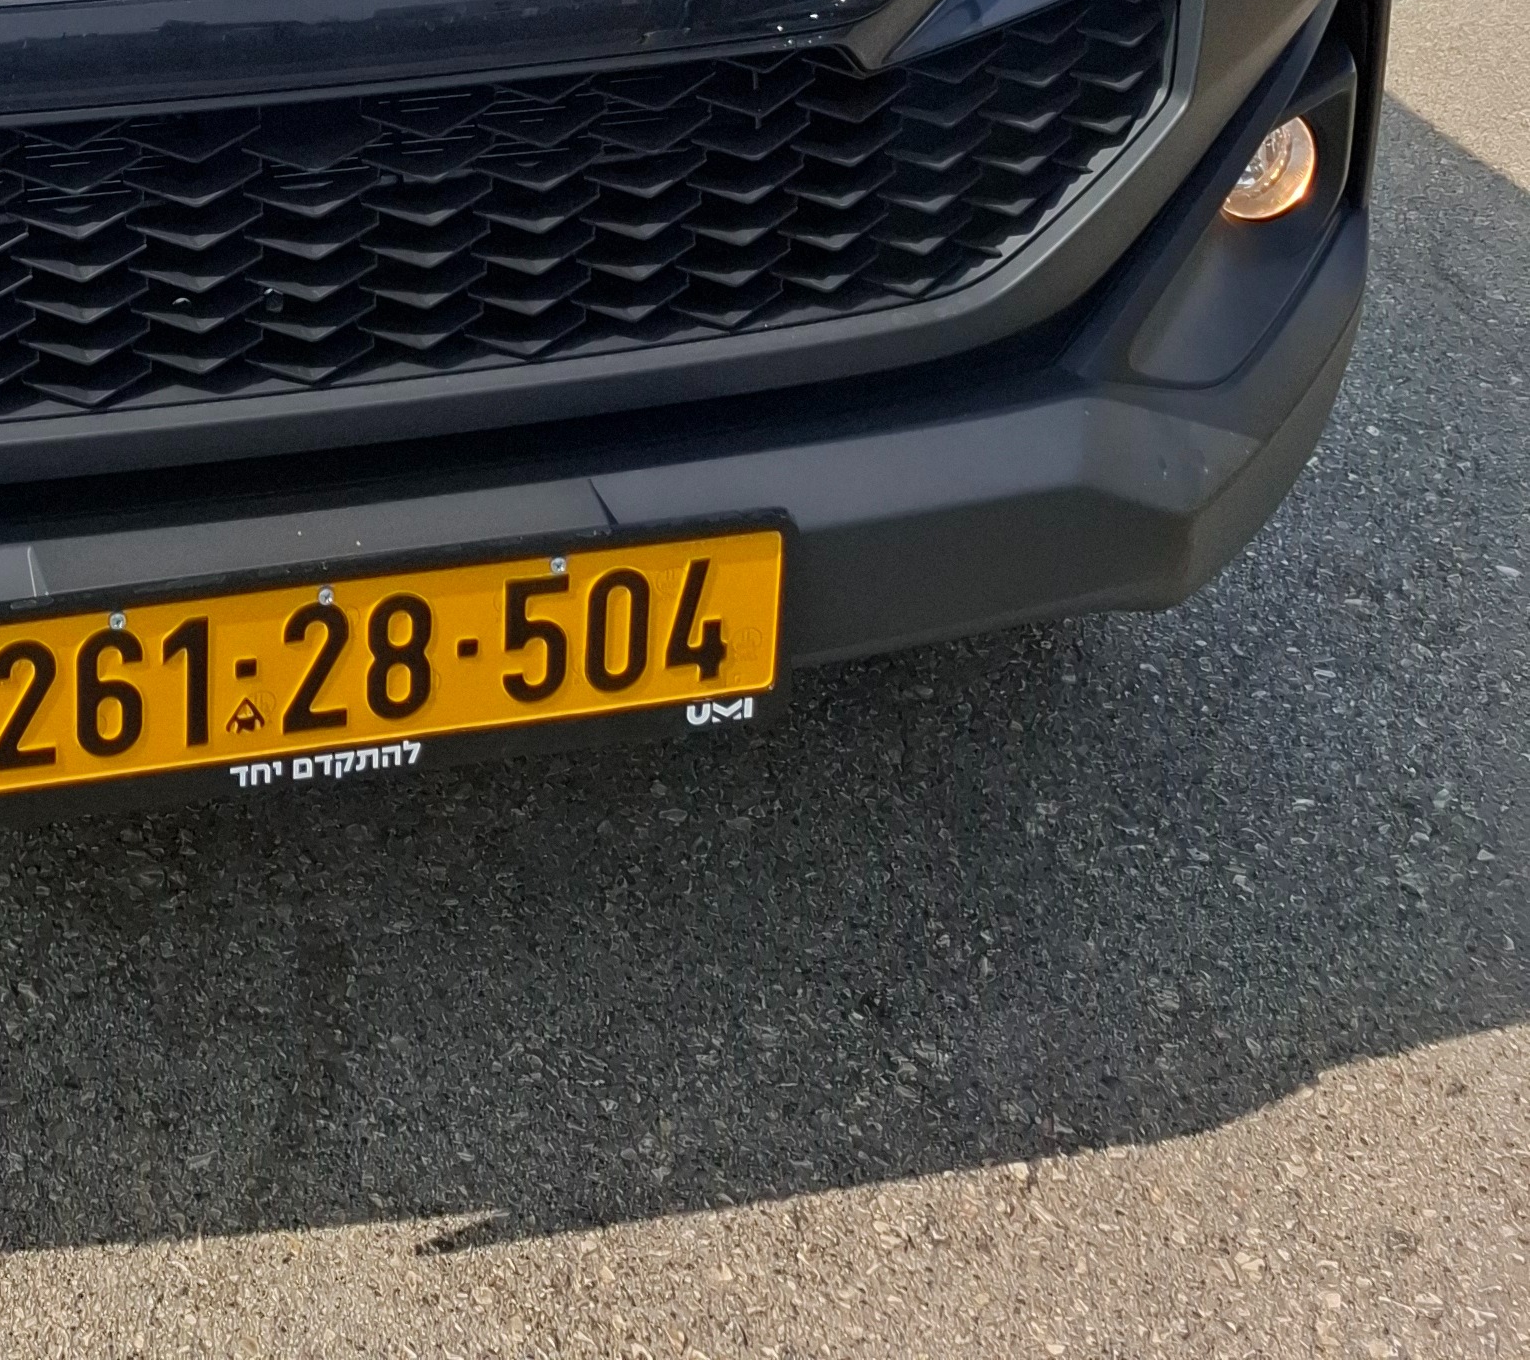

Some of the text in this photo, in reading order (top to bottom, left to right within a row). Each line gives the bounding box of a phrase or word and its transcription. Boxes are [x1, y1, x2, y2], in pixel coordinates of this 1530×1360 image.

[686, 696, 753, 725] UMI
[229, 740, 421, 787] להתקדם יחד
